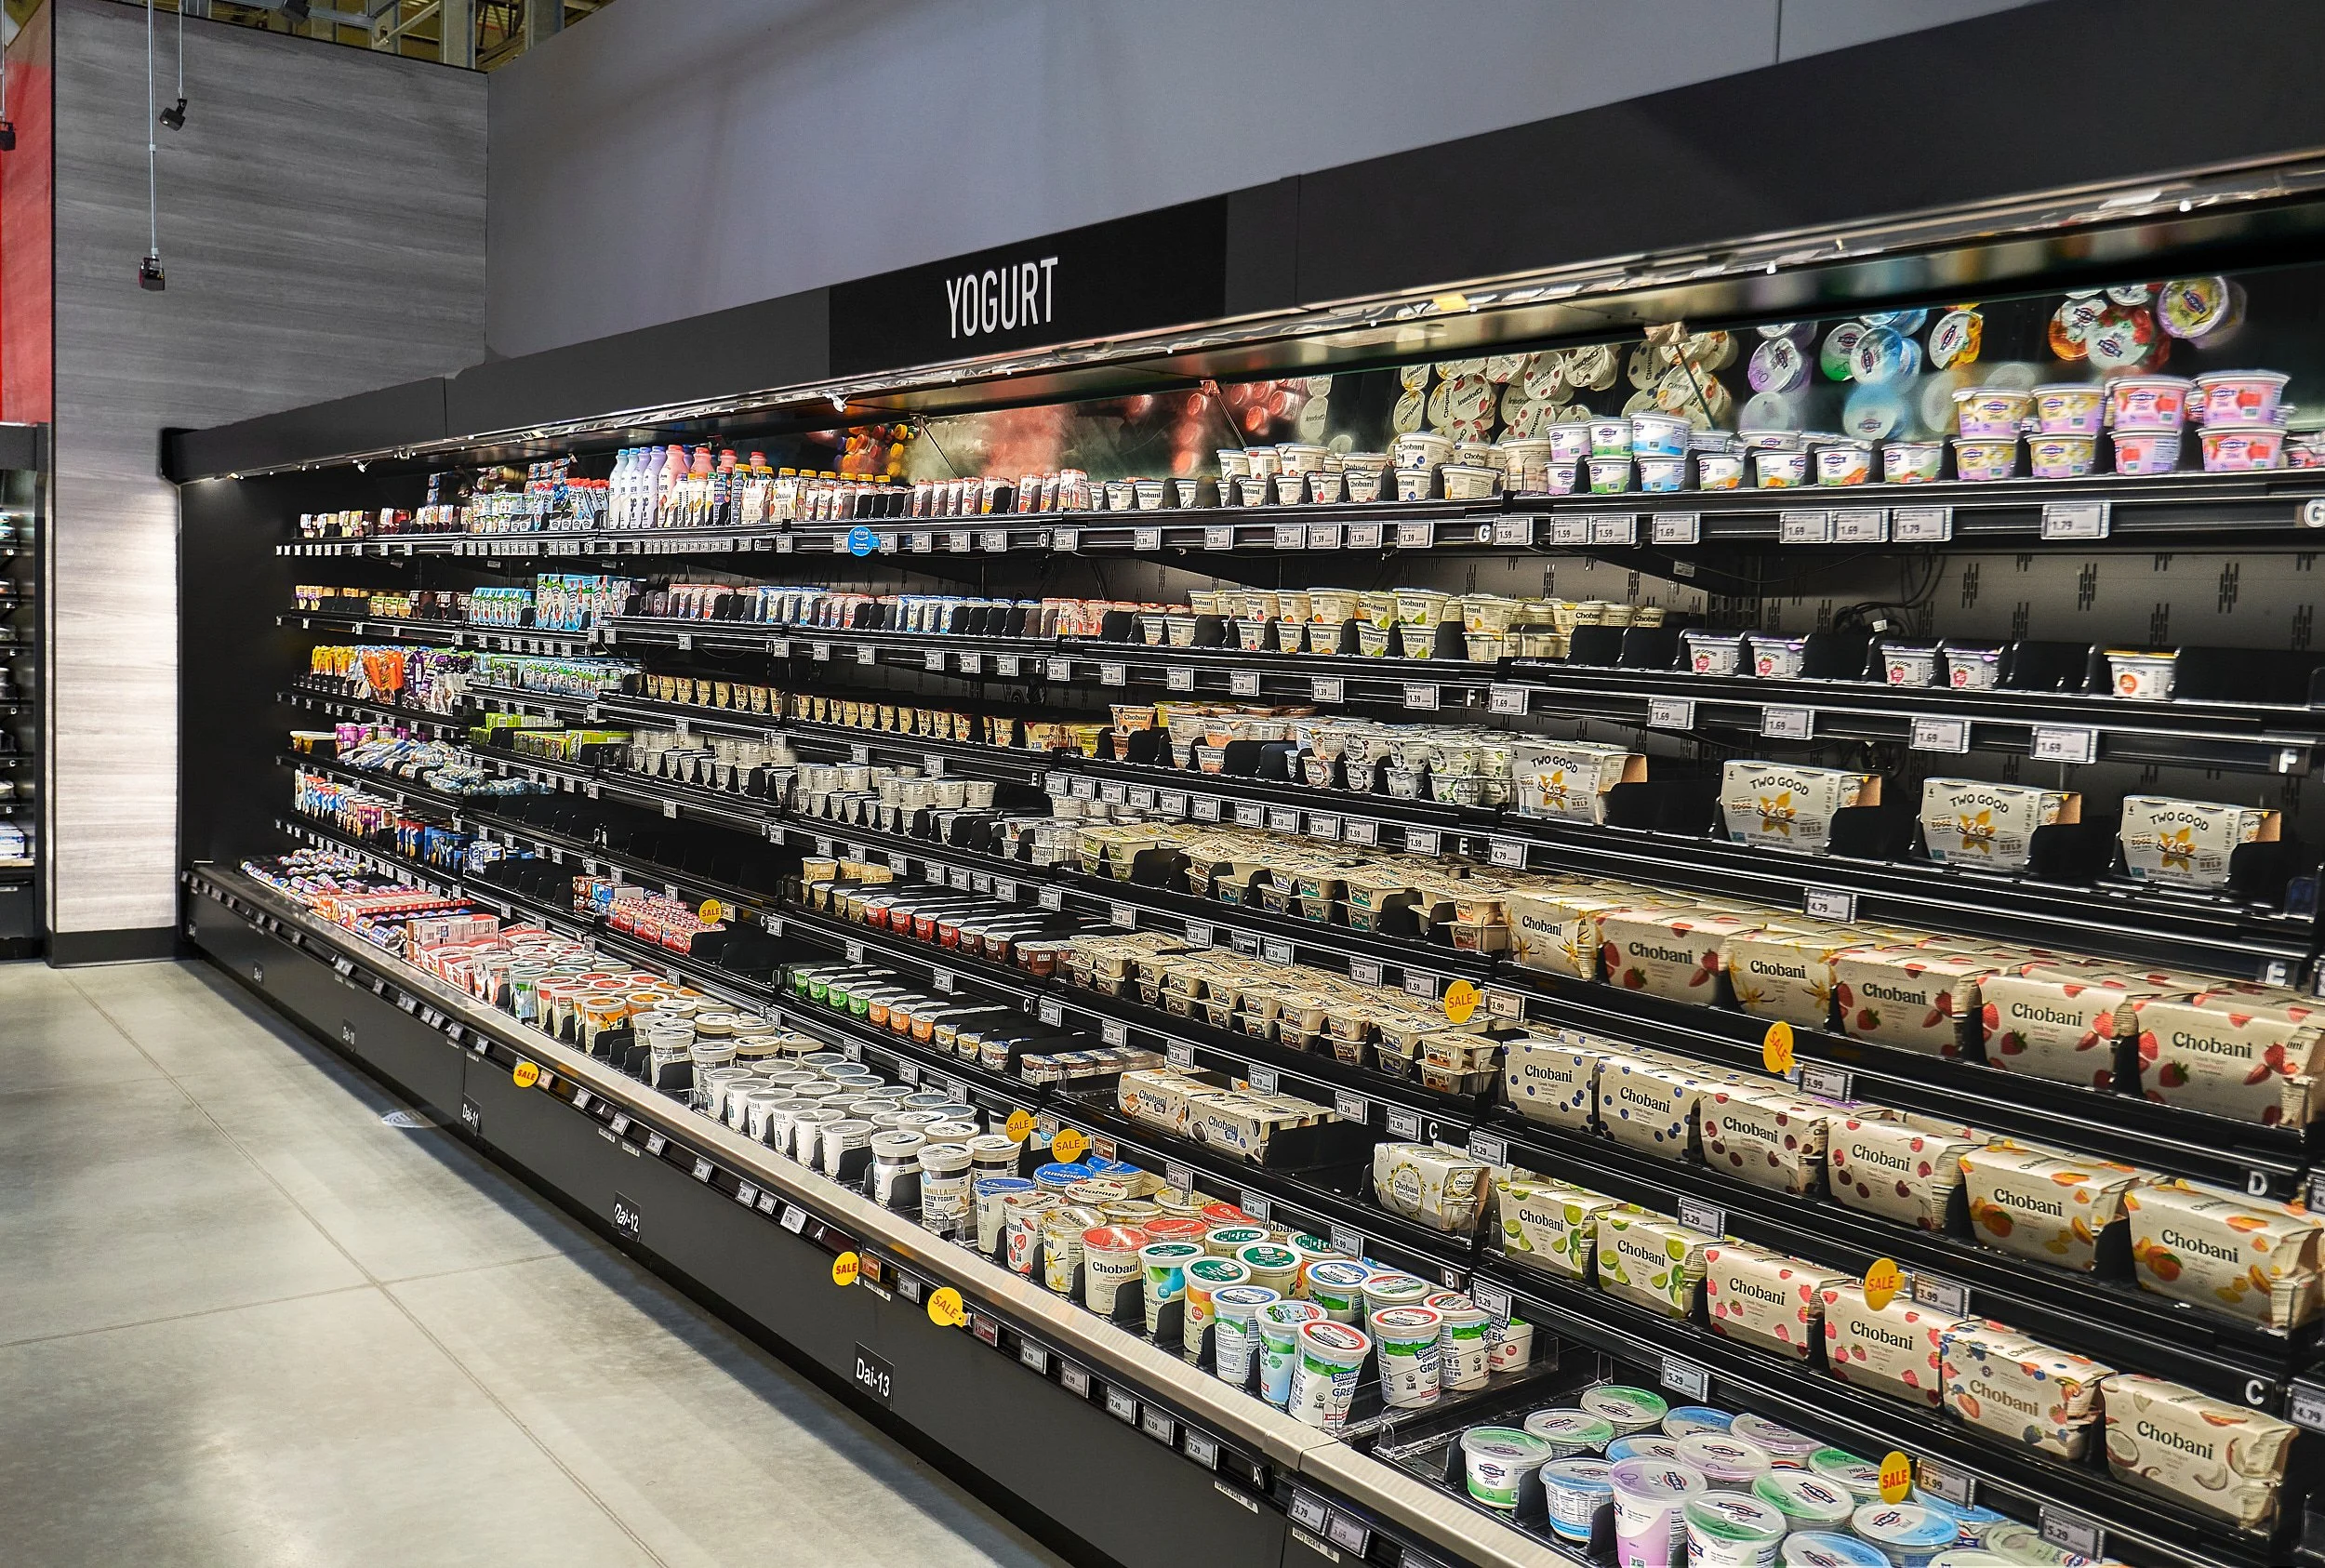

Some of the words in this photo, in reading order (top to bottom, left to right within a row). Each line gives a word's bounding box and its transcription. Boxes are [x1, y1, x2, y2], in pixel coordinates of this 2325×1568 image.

[947, 257, 1058, 339] YOGURT
[2304, 499, 2325, 527] G
[1039, 533, 1047, 547] G
[1479, 525, 1490, 541] G
[1400, 599, 1427, 608] Chobani
[1467, 689, 1476, 707] F
[1531, 755, 1552, 768] TWO
[1552, 756, 1578, 773] GOOD
[2278, 749, 2297, 773] F
[1749, 777, 1776, 790] TWO
[1777, 777, 1809, 796] GOOD
[1949, 794, 1975, 807] TWO
[1977, 795, 2009, 813] GOOD
[2149, 812, 2174, 825] TWO
[2176, 813, 2209, 831] GOOD
[1459, 838, 1468, 855] E
[702, 909, 720, 918] SALE
[1521, 915, 1562, 937] Chobani
[1628, 942, 1693, 965] Chobani
[1750, 960, 1806, 979] Chobani
[2265, 961, 2286, 986] E
[1448, 992, 1473, 1009] SALE
[1862, 982, 1927, 1006] Chobani
[2012, 1003, 2083, 1027] Chobani
[1768, 1030, 1787, 1062] SALE
[2172, 1031, 2252, 1059] Chobani
[517, 1070, 536, 1081] SALE
[1524, 1064, 1574, 1083] Chobani
[1138, 1088, 1167, 1106] Chobani
[1620, 1086, 1670, 1114] Chobani
[461, 1103, 479, 1128] Dai-11
[1008, 1119, 1030, 1132] SALE
[1208, 1115, 1239, 1134] Chobani
[1428, 1122, 1439, 1139] C
[1722, 1117, 1778, 1144] Chobani
[1056, 1139, 1080, 1151] SALE
[1853, 1144, 1910, 1173] Chobani
[2248, 1171, 2267, 1196] D
[1994, 1189, 2063, 1217] Chobani
[1519, 1209, 1564, 1232] Chobani
[814, 1227, 825, 1239] A
[1617, 1240, 1665, 1267] Chobani
[2161, 1229, 2239, 1264] Chobani
[835, 1263, 857, 1275] SALE
[1092, 1260, 1138, 1275] Chobani
[1445, 1271, 1455, 1287] B
[1868, 1276, 1894, 1293] SALE
[1730, 1277, 1786, 1306] Chobani
[932, 1295, 959, 1319] SALE
[1851, 1321, 1913, 1350] Chobani
[856, 1357, 890, 1397] Dai-13
[1969, 1380, 2039, 1416] Chobani
[2245, 1380, 2265, 1405] C
[2136, 1420, 2213, 1460] Chobani
[1882, 1469, 1907, 1490] SALE
